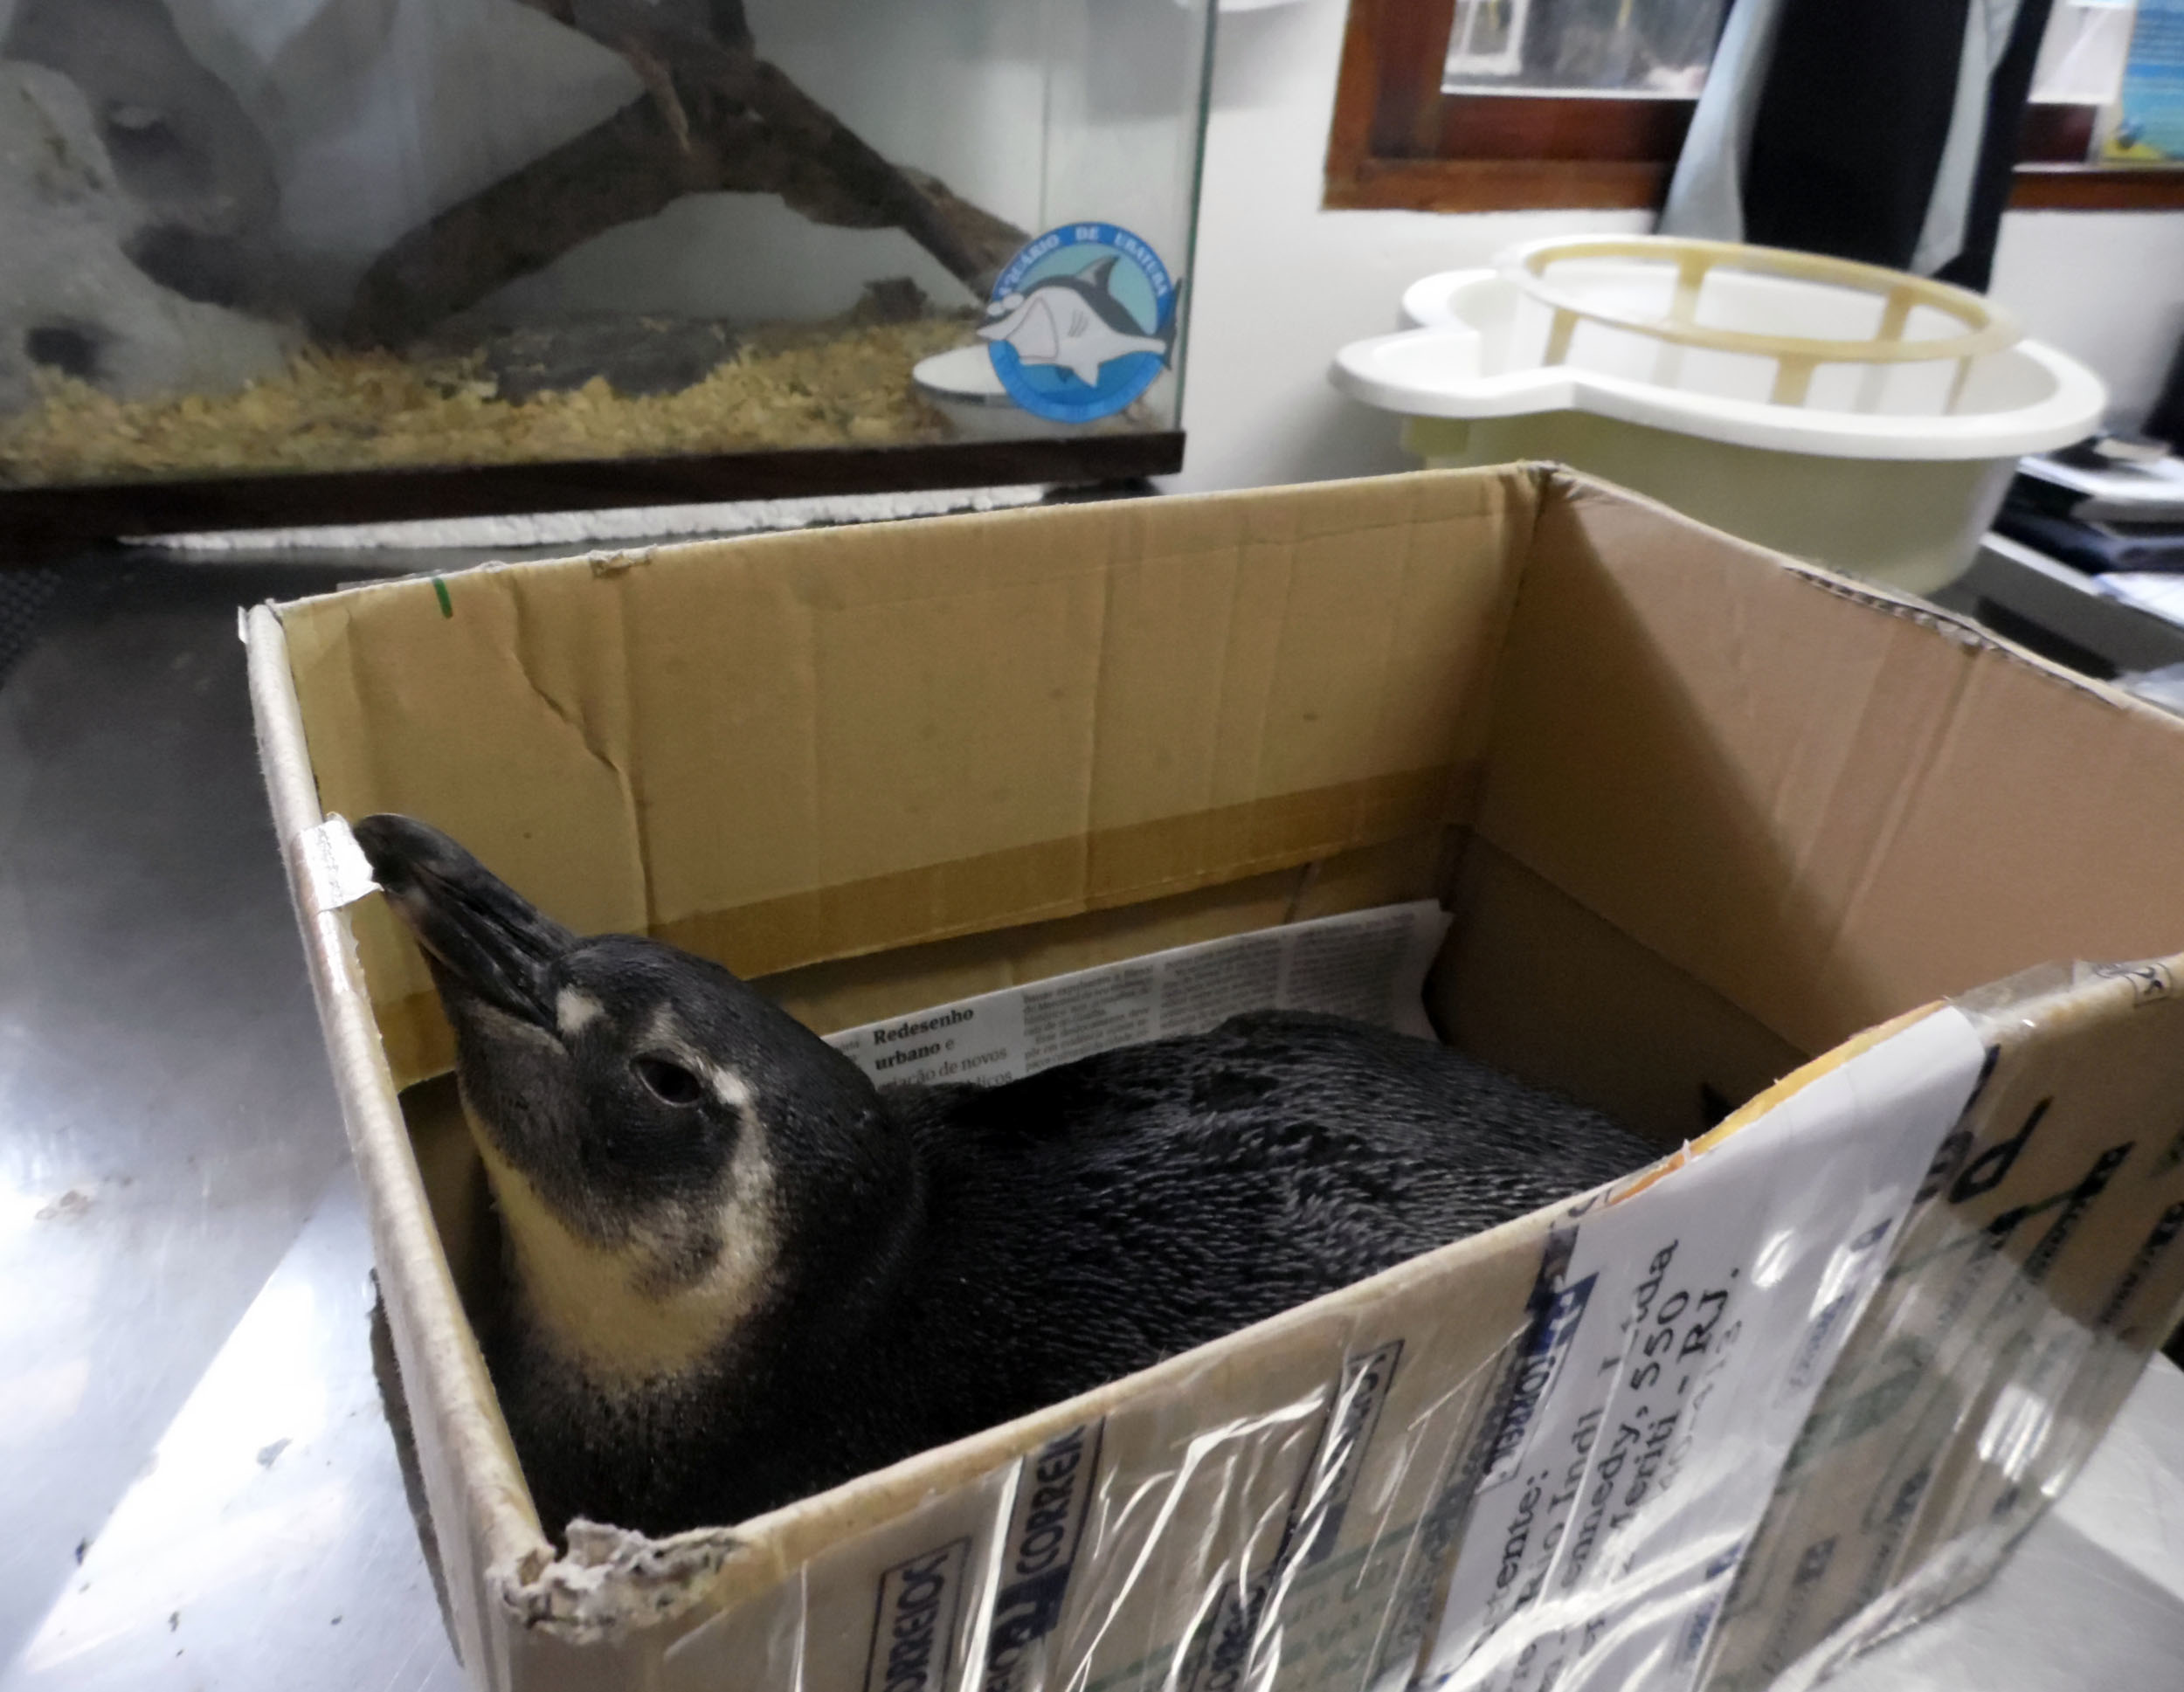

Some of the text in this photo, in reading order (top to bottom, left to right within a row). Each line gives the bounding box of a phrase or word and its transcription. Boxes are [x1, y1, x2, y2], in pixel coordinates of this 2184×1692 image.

[1075, 226, 1099, 242] DE
[874, 1008, 974, 1046] Redesenho
[875, 1041, 941, 1071] urbano
[945, 1038, 955, 1051] e
[939, 1060, 958, 1078] de
[962, 1047, 1007, 1071] novos
[1676, 1267, 1739, 1364] RJ.
[1560, 1405, 1648, 1588] ennedy,
[1629, 1290, 1689, 1391] 550
